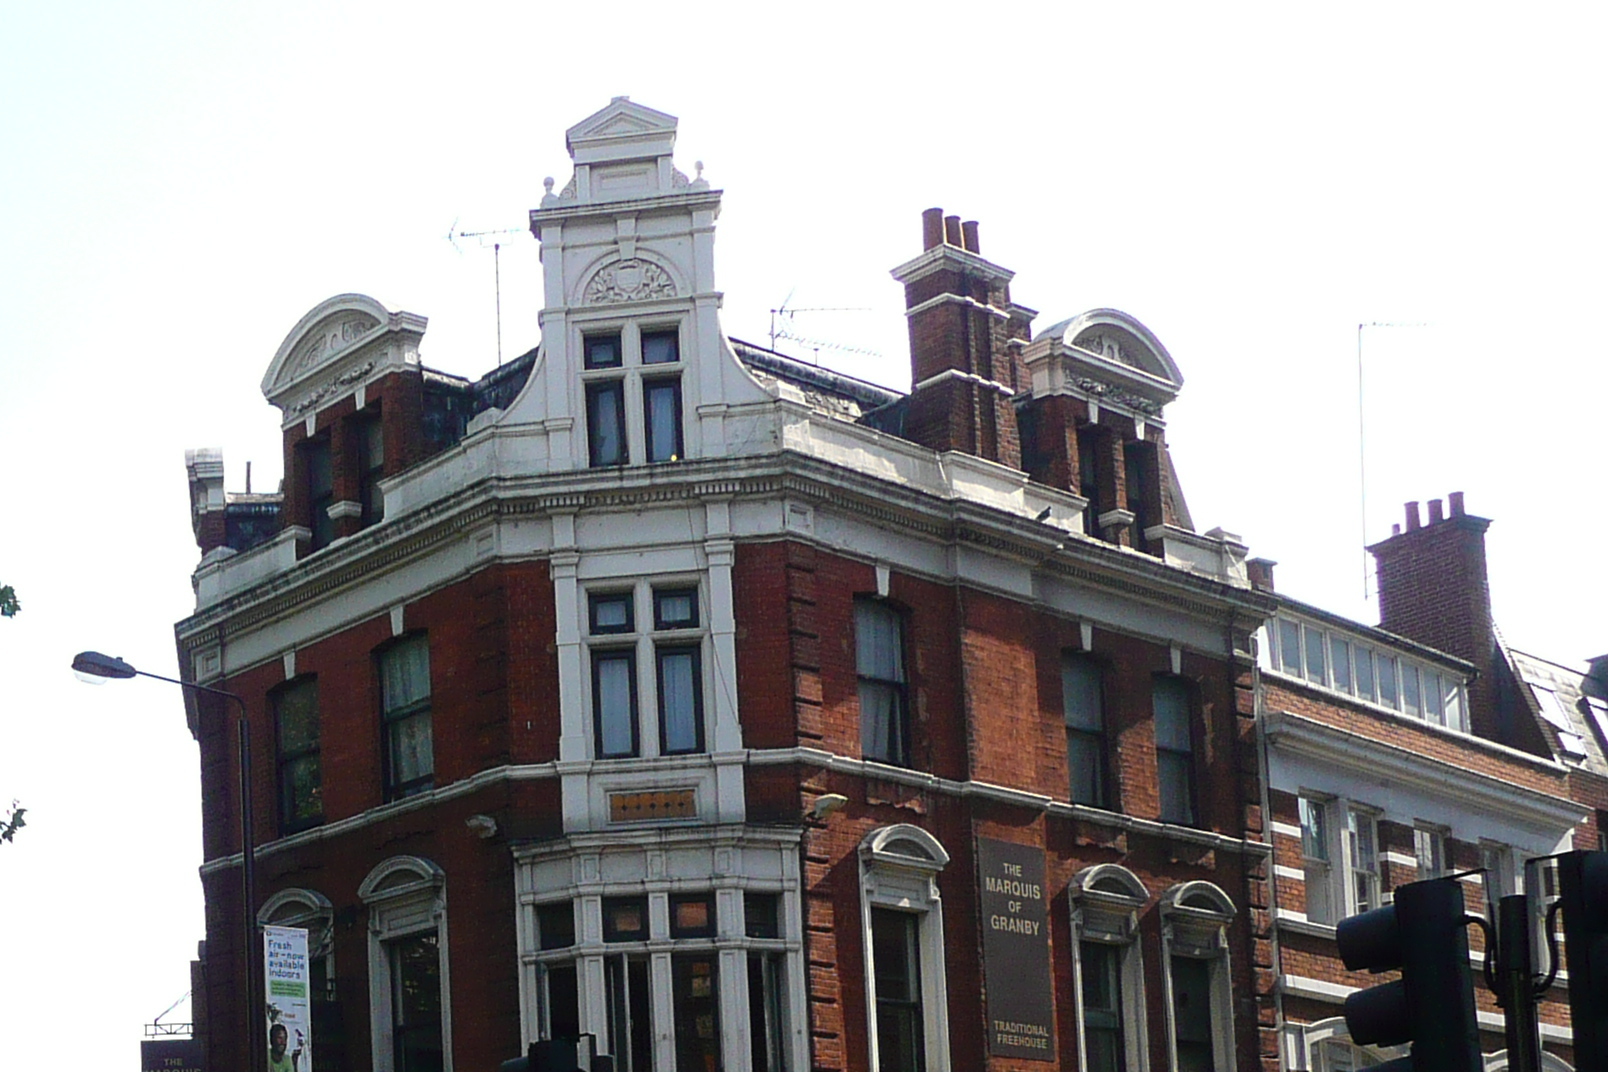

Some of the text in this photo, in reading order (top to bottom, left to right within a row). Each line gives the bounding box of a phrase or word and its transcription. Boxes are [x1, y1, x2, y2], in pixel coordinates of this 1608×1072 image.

[1003, 862, 1022, 877] THE
[985, 877, 1041, 899] MARQUIS
[1008, 901, 1022, 913] OF
[991, 914, 1039, 936] GRANBY
[268, 939, 292, 950] Fresh
[269, 960, 305, 970] available
[994, 1020, 1049, 1037] TRADITIONAL
[997, 1033, 1048, 1049] FREEHOUSE
[164, 1058, 183, 1067] THE
